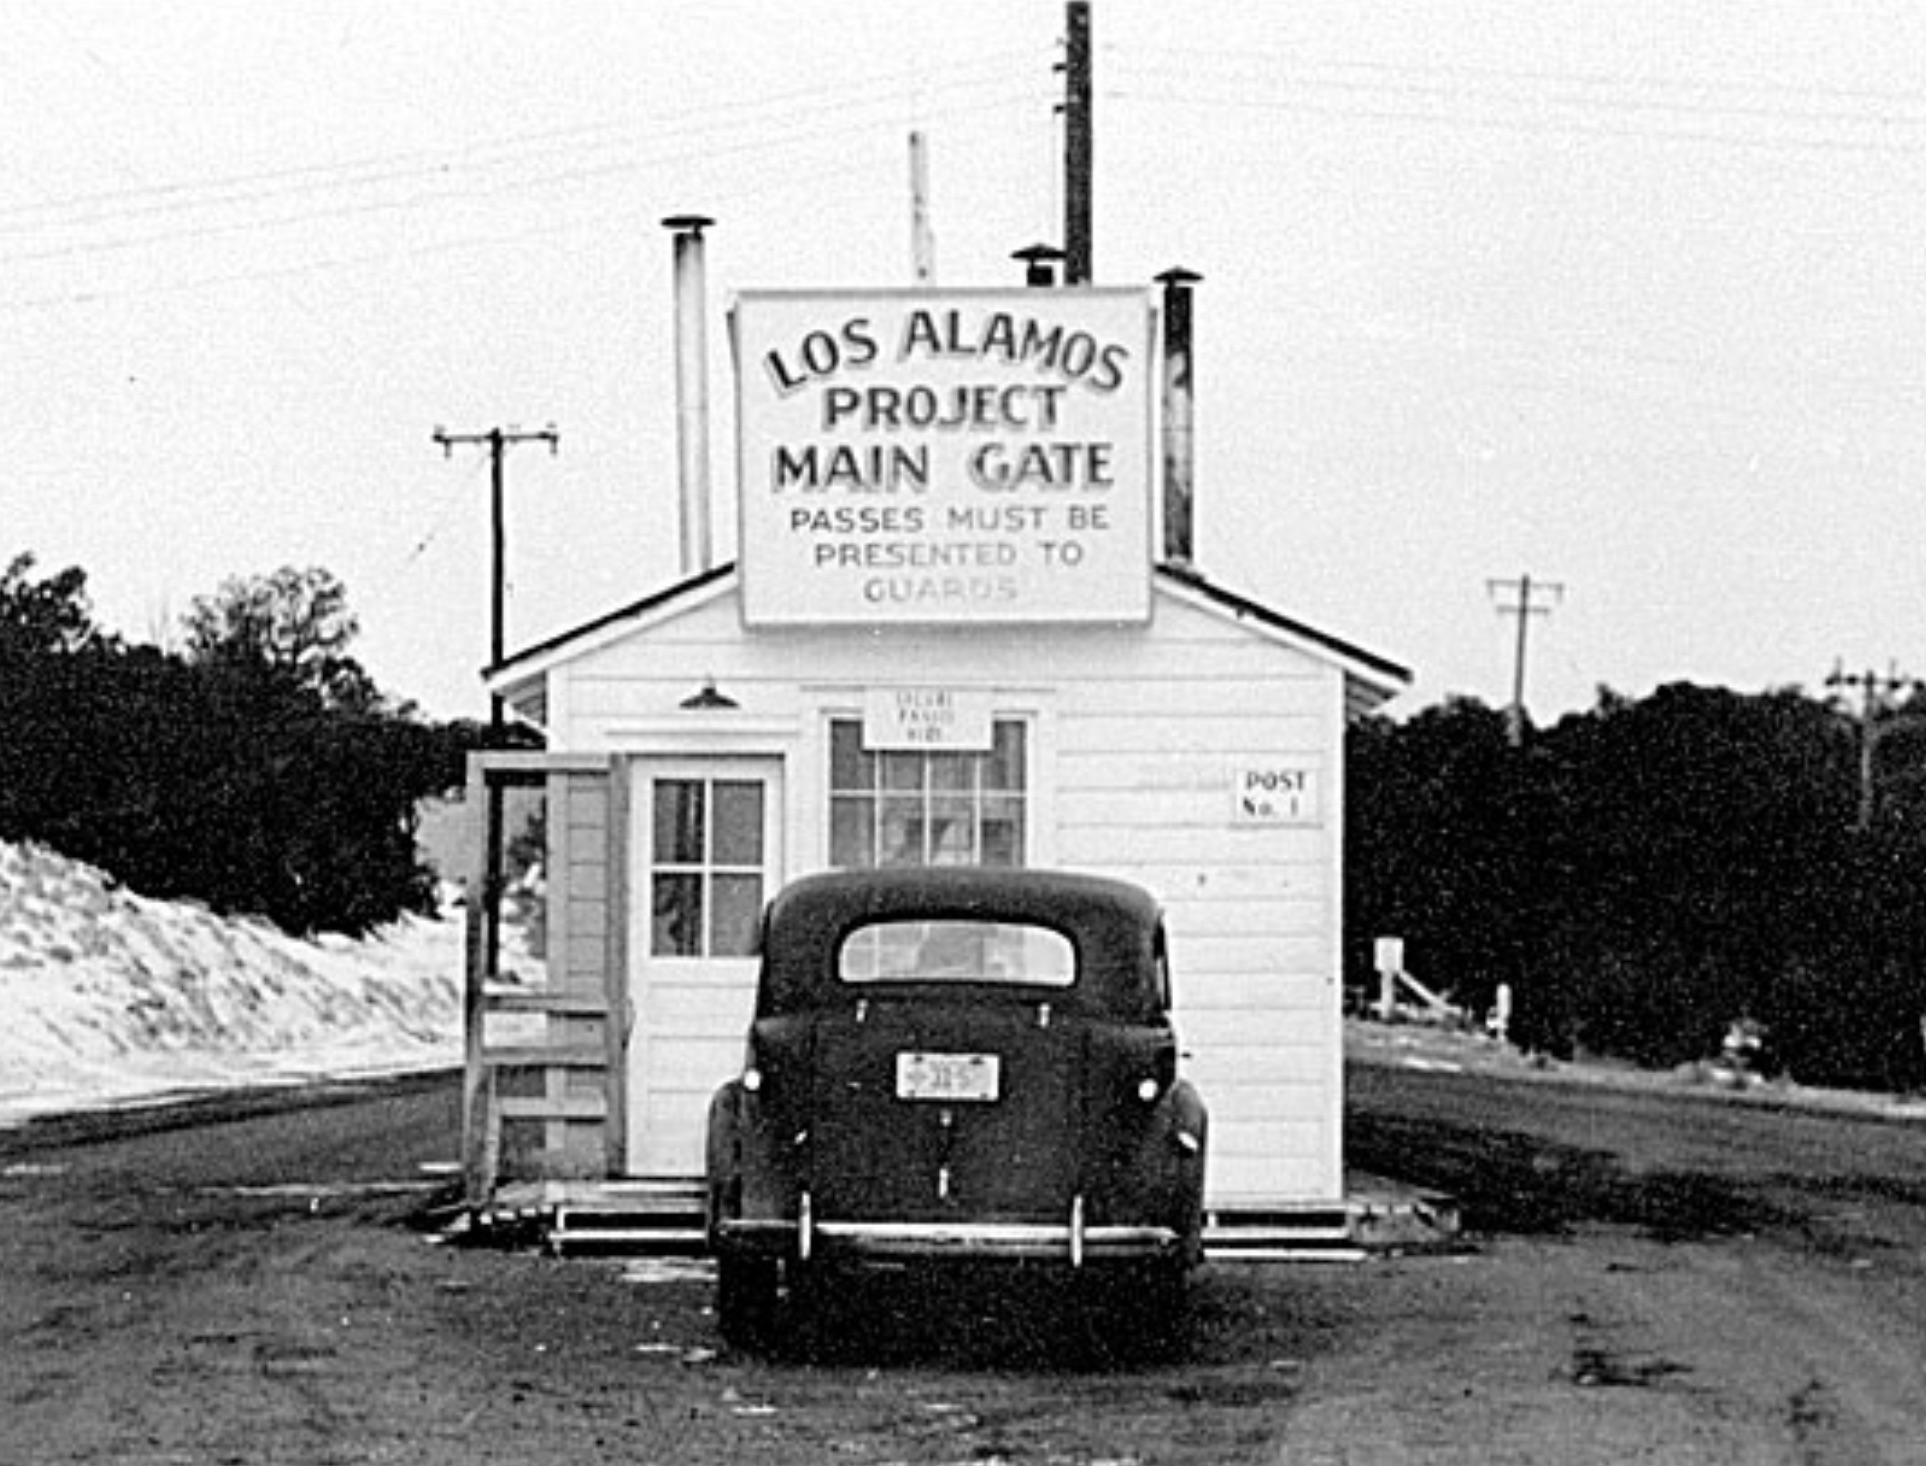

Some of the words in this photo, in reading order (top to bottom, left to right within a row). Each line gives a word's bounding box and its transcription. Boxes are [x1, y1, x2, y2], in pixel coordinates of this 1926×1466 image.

[765, 318, 878, 394] LOS
[900, 309, 1130, 393] ALAMOS
[822, 384, 1068, 431] PROJECT
[772, 443, 929, 493] MAIN
[968, 442, 1114, 492] GATE
[790, 506, 924, 534] PASSES
[946, 505, 1048, 532] MUST
[1068, 504, 1111, 531] BE
[815, 541, 1017, 568] PRESENTED
[1037, 541, 1083, 566] TO
[863, 577, 1018, 602] GUARDS
[1246, 770, 1305, 792] POST
